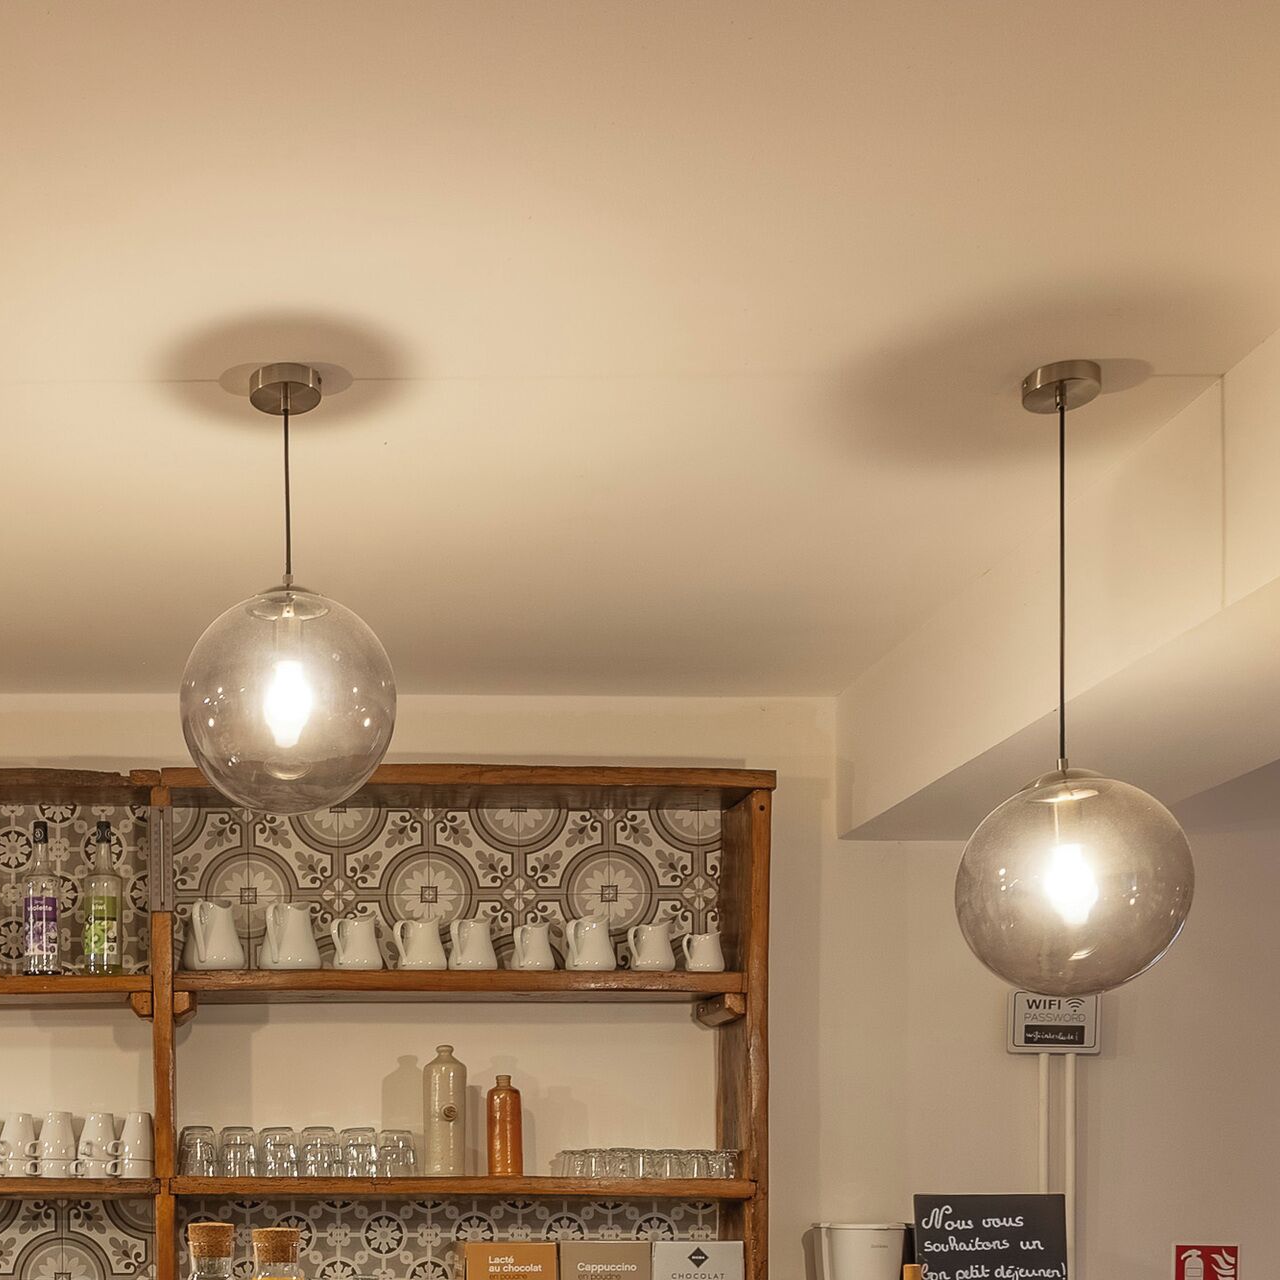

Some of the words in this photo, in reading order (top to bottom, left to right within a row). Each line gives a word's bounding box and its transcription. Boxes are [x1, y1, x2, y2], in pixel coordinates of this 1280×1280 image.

[1026, 999, 1061, 1010] WIFI
[1024, 1012, 1086, 1022] PASSWORD
[922, 1205, 974, 1230] Nous
[982, 1216, 1024, 1228] vous
[924, 1236, 1010, 1252] souhaitons
[1020, 1240, 1044, 1250] un
[488, 1256, 514, 1264] Lacté
[502, 1264, 542, 1272] chocolat
[577, 1262, 638, 1274] Cappuccino
[590, 1273, 622, 1280] poudre
